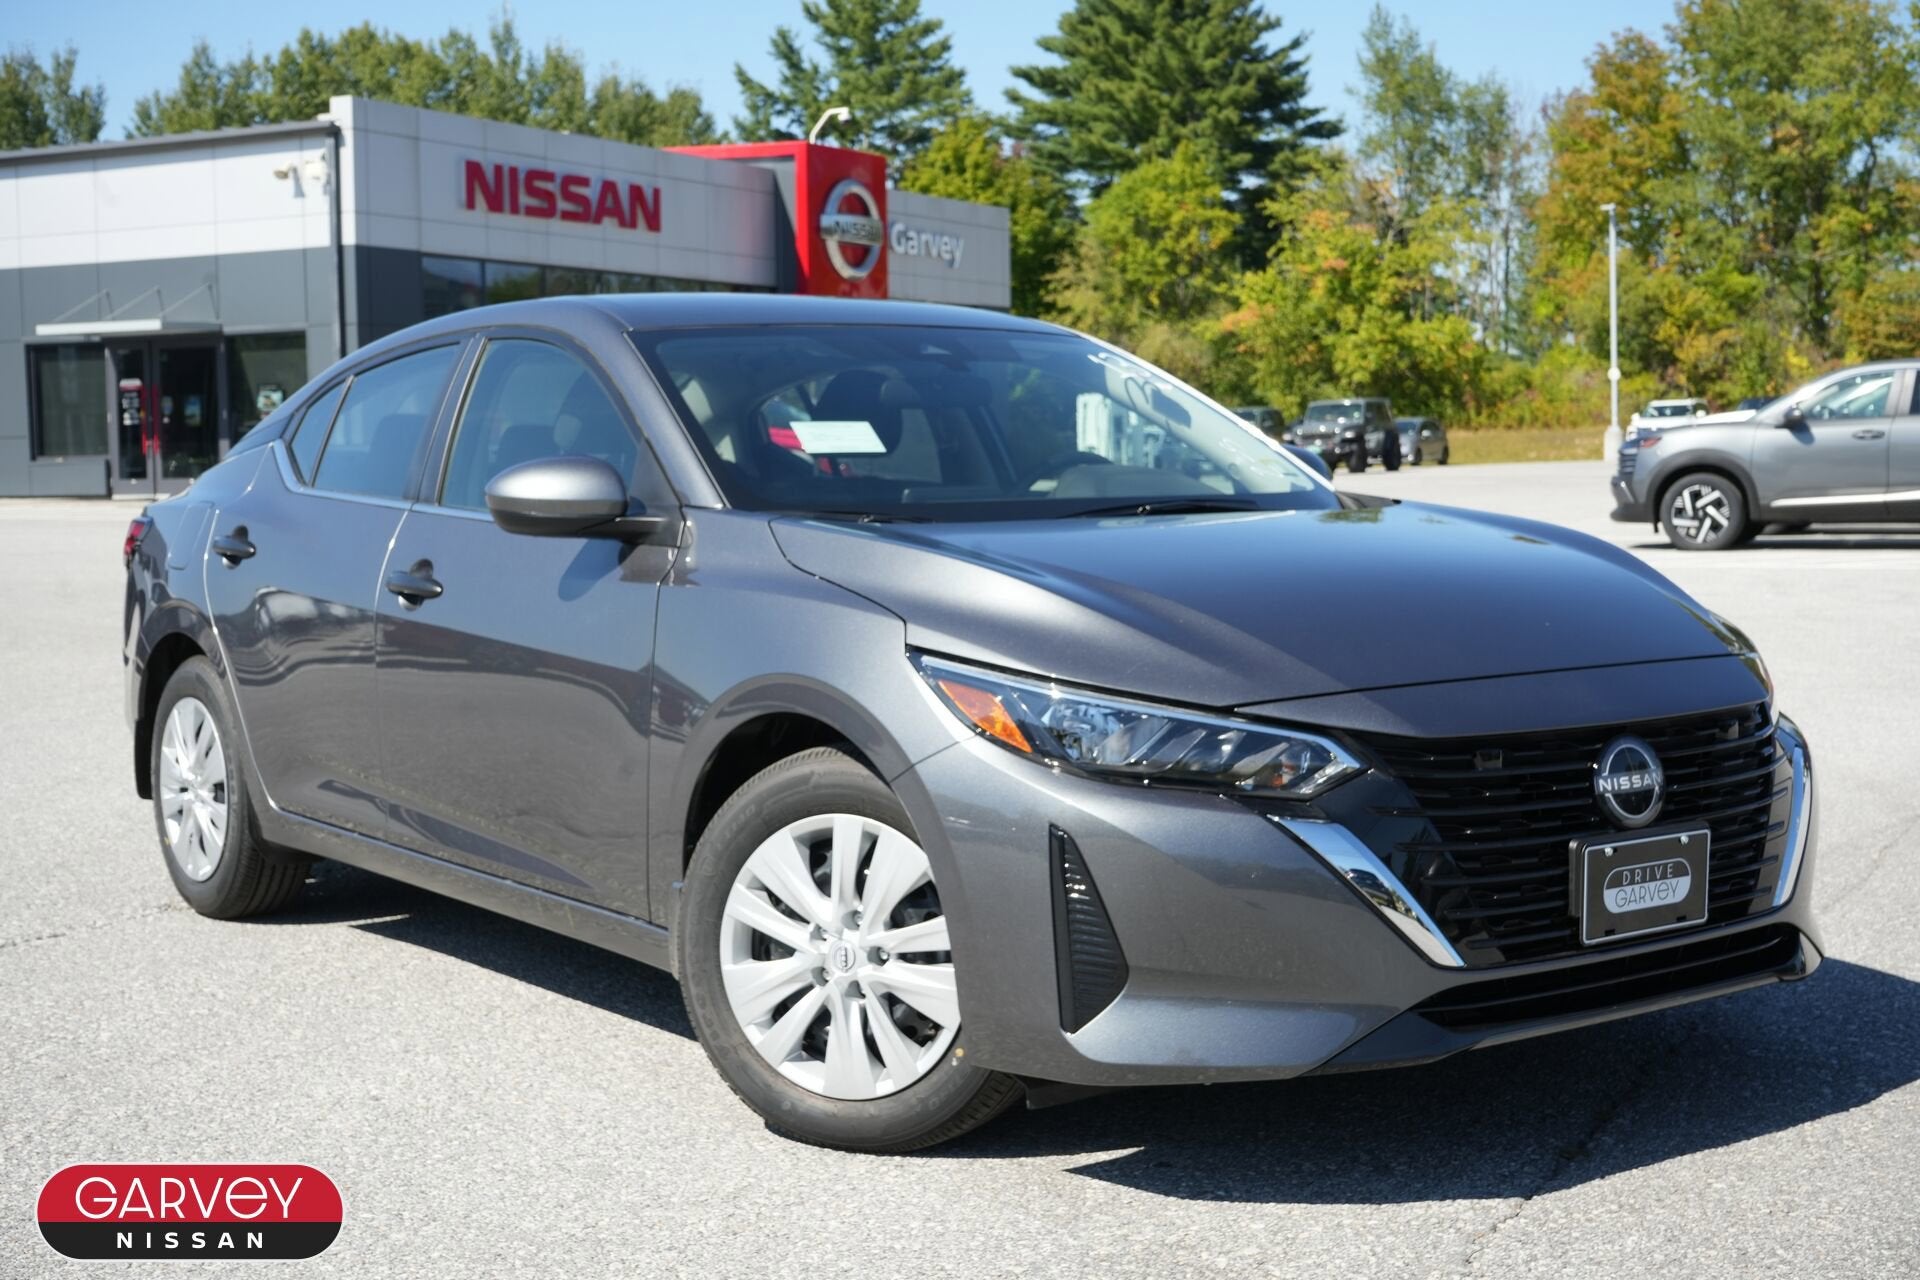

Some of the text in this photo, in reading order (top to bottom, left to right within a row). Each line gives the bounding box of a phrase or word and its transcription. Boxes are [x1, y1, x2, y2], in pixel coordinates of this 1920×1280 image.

[464, 159, 662, 234] NISSAN
[890, 222, 964, 269] Garvey
[1599, 771, 1661, 792] NISSAN
[1622, 863, 1674, 885] DRIVE
